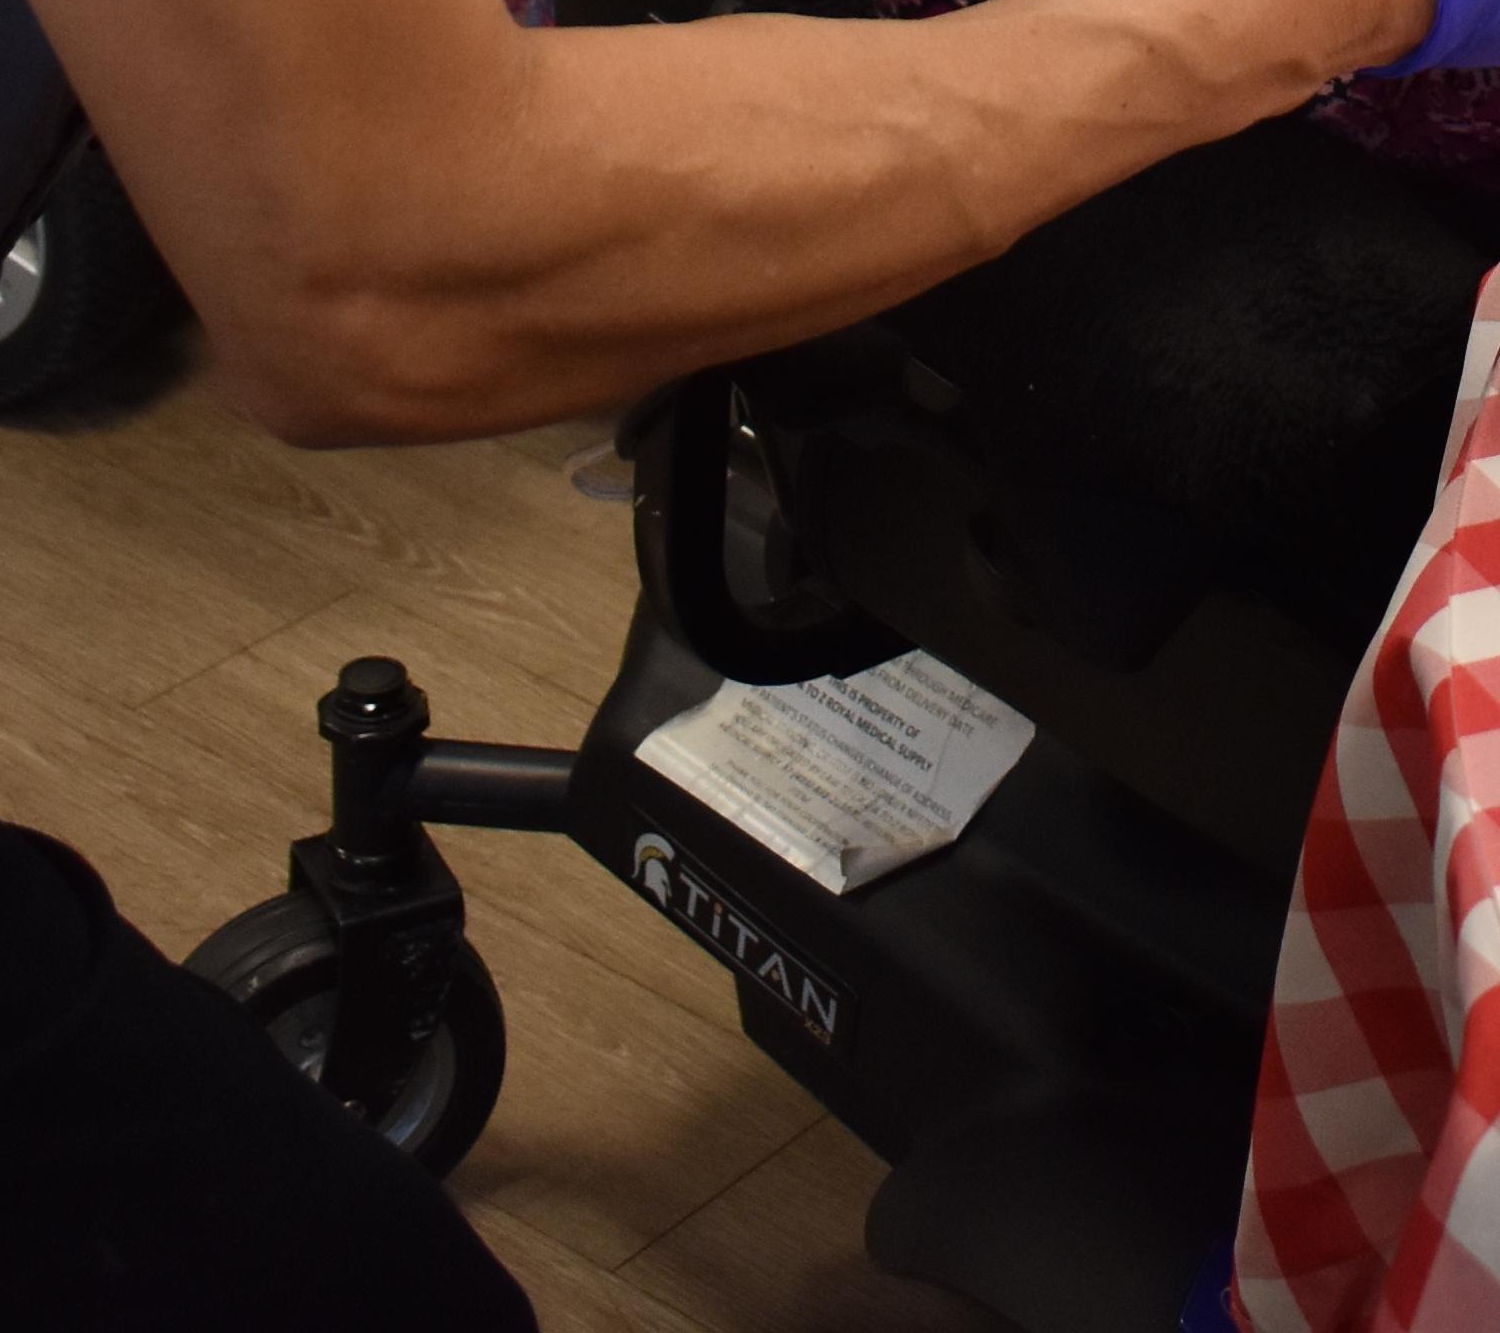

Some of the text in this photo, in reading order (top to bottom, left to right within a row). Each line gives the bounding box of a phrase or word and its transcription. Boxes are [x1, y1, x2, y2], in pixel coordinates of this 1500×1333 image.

[802, 683, 821, 699] TO
[823, 695, 860, 724] ROYAL
[853, 716, 900, 750] MEDICAL
[894, 743, 934, 774] SUPPLY
[846, 687, 862, 702] IS
[856, 694, 906, 731] PROPERTY
[902, 723, 921, 740] OF
[903, 686, 952, 722] DELIVERY
[946, 714, 976, 738] DATE
